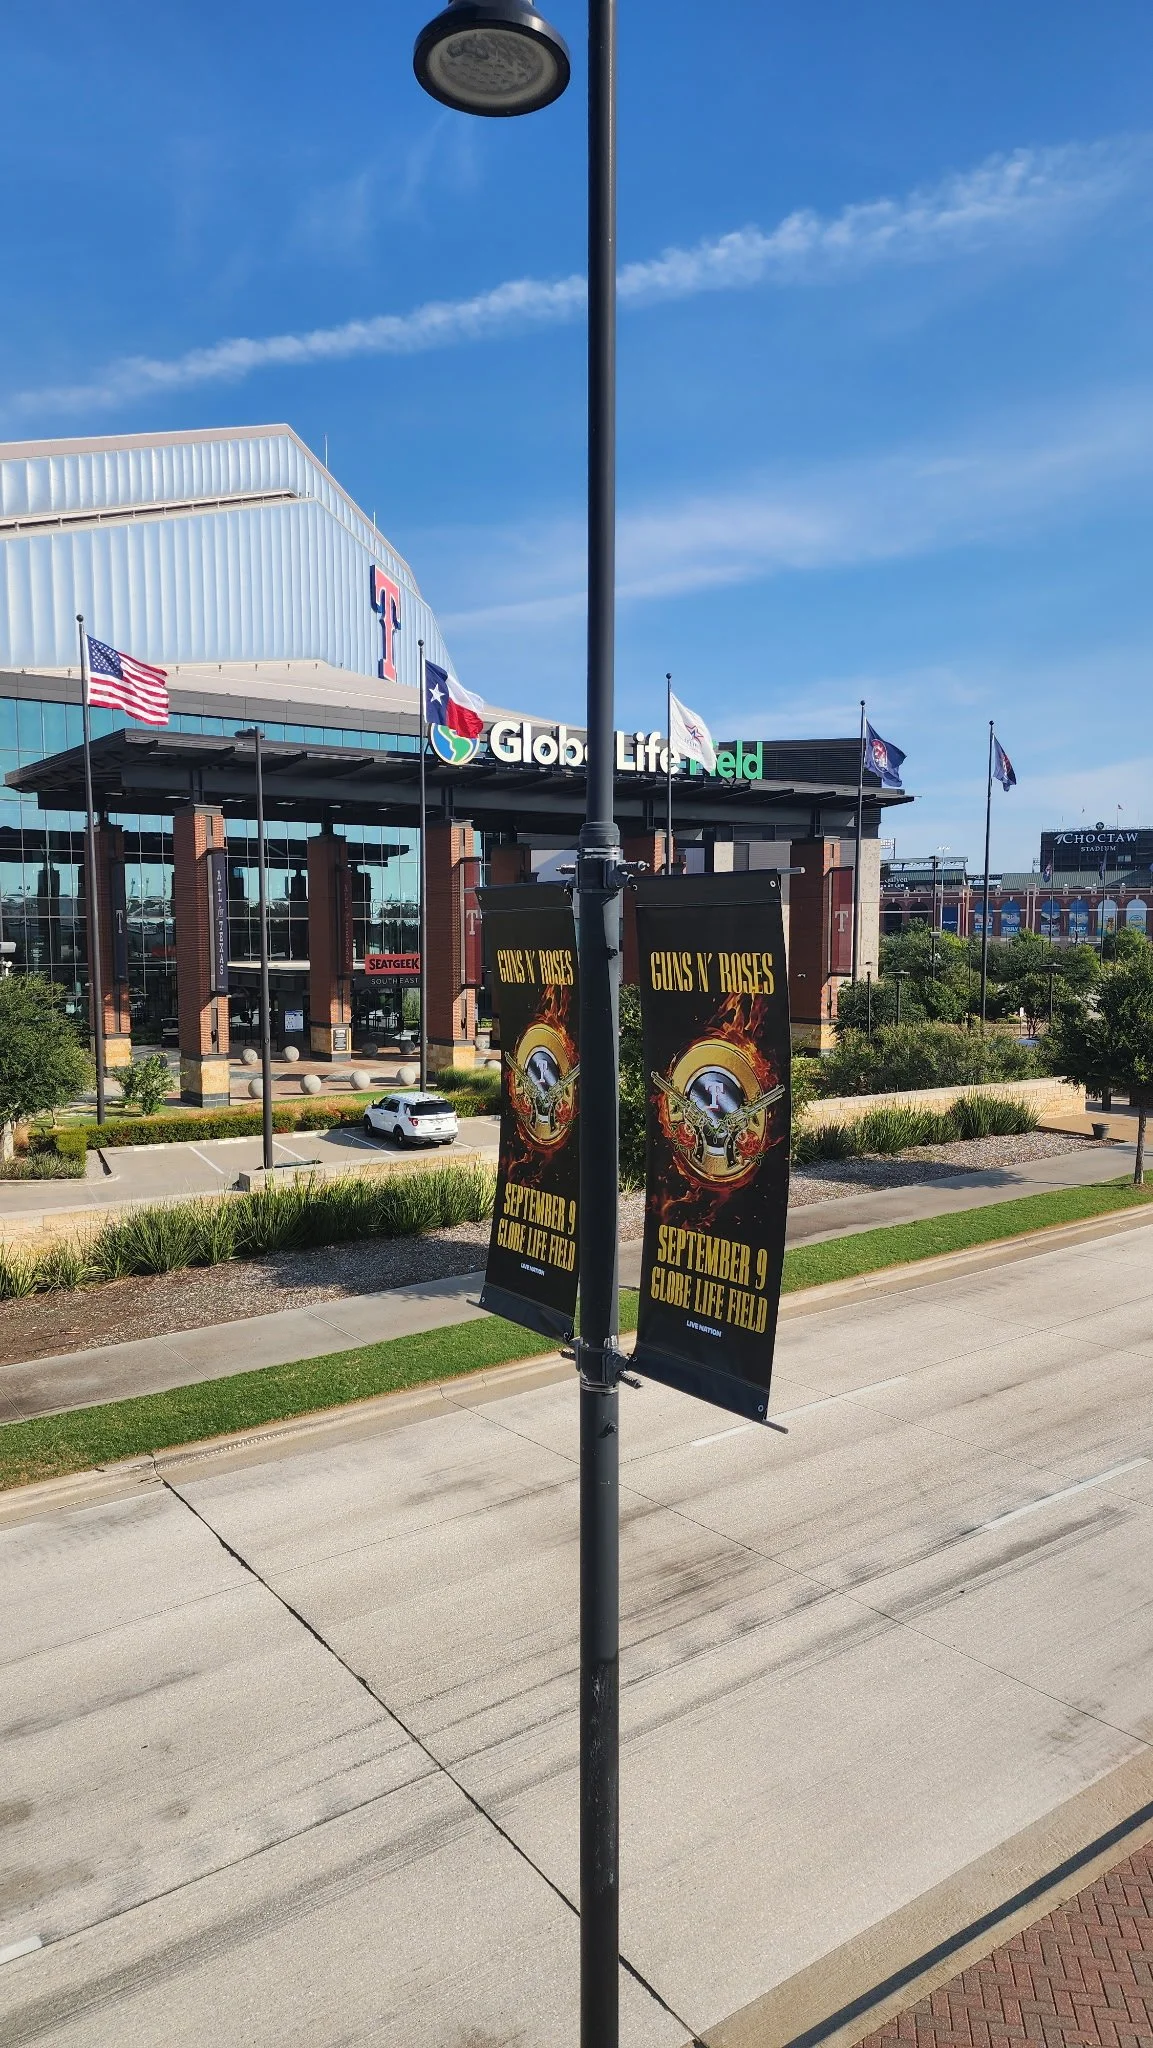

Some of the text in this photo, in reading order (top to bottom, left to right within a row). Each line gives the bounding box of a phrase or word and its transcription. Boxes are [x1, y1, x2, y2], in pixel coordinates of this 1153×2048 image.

[370, 565, 401, 682] T
[490, 721, 587, 767] Glob
[616, 730, 680, 775] Life
[1062, 832, 1139, 844] CHOCTAW
[466, 909, 478, 935] T
[834, 910, 849, 932] T
[369, 957, 420, 971] SEATGEEK
[497, 949, 526, 984] GUNS
[538, 949, 574, 986] ROSES
[650, 951, 775, 995] GUNS N' ROSES
[503, 1182, 577, 1235] SEPTEMBER 9
[497, 1218, 576, 1272] GLOBE LIFE FIELD
[657, 1224, 768, 1290] SEPTEMBER 9
[650, 1266, 768, 1334] GLOBE LIFE FIELD
[686, 1320, 722, 1337] LIVE NATION
